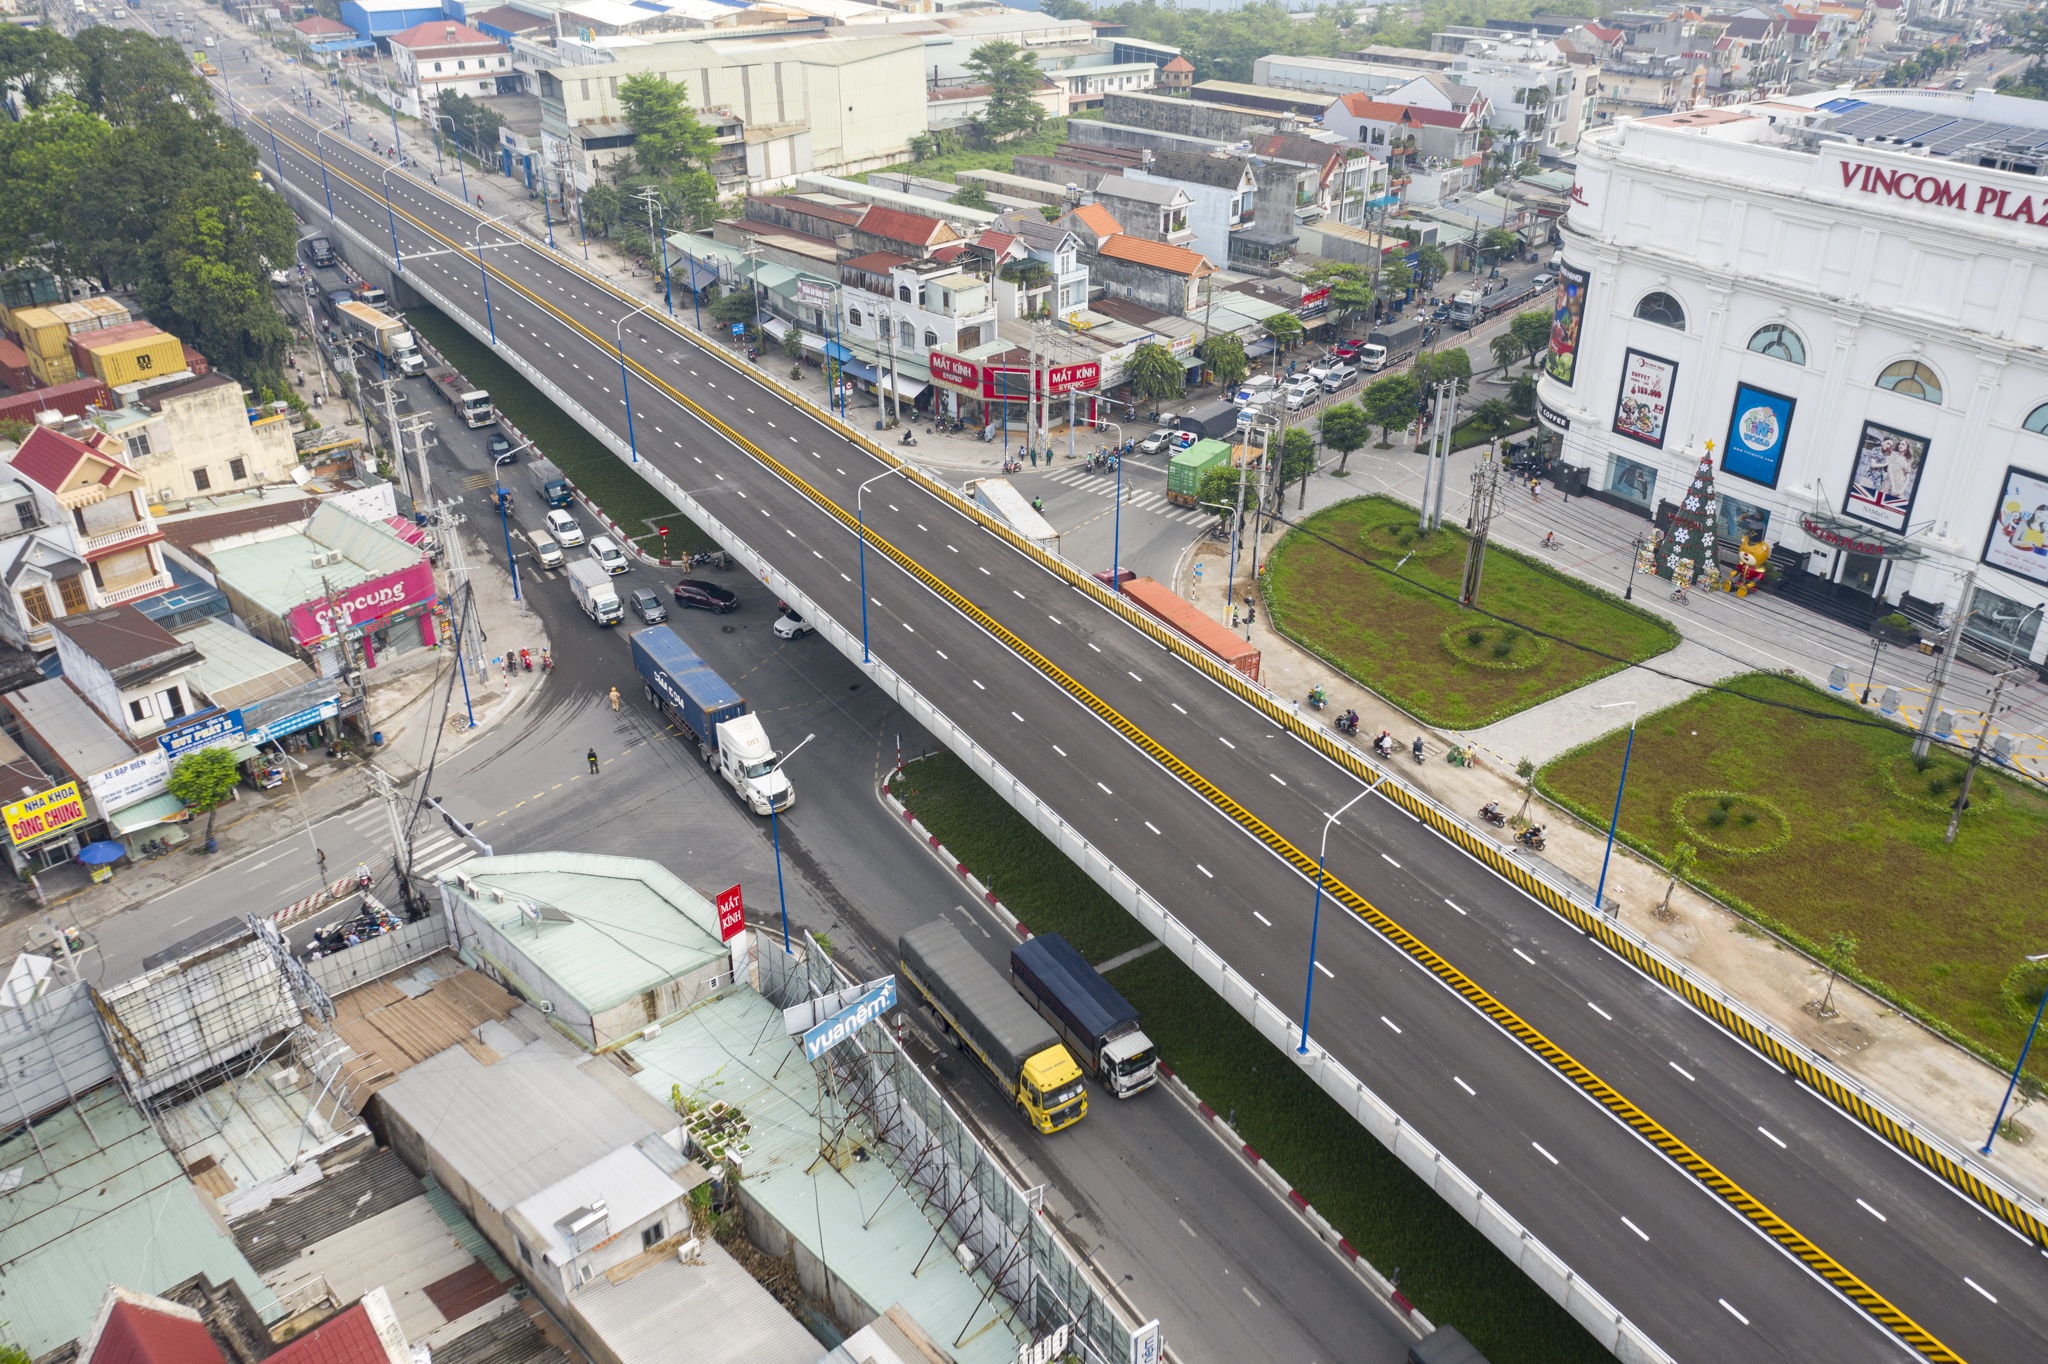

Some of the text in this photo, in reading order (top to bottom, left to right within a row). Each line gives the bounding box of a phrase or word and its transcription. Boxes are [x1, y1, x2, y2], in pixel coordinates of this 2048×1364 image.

[1839, 161, 1967, 211] VINCOM
[933, 355, 972, 378] MẮT KÍNH
[1052, 369, 1072, 384] MẮT
[1076, 366, 1096, 379] KÍNH
[1631, 371, 1651, 381] BUFFET
[1543, 409, 1566, 427] COFFEE
[1743, 432, 1770, 448] WORLD
[1841, 536, 1885, 555] PLAZA
[170, 734, 193, 749] HUY
[194, 724, 222, 741] PHÁT
[103, 758, 147, 781] XE ĐẠP ĐIỆN
[24, 786, 75, 813] NHA KHOA
[11, 812, 45, 842] CÔNG
[45, 800, 82, 829] CHUNG
[720, 896, 740, 915] MẮT
[722, 911, 742, 930] KÍNH
